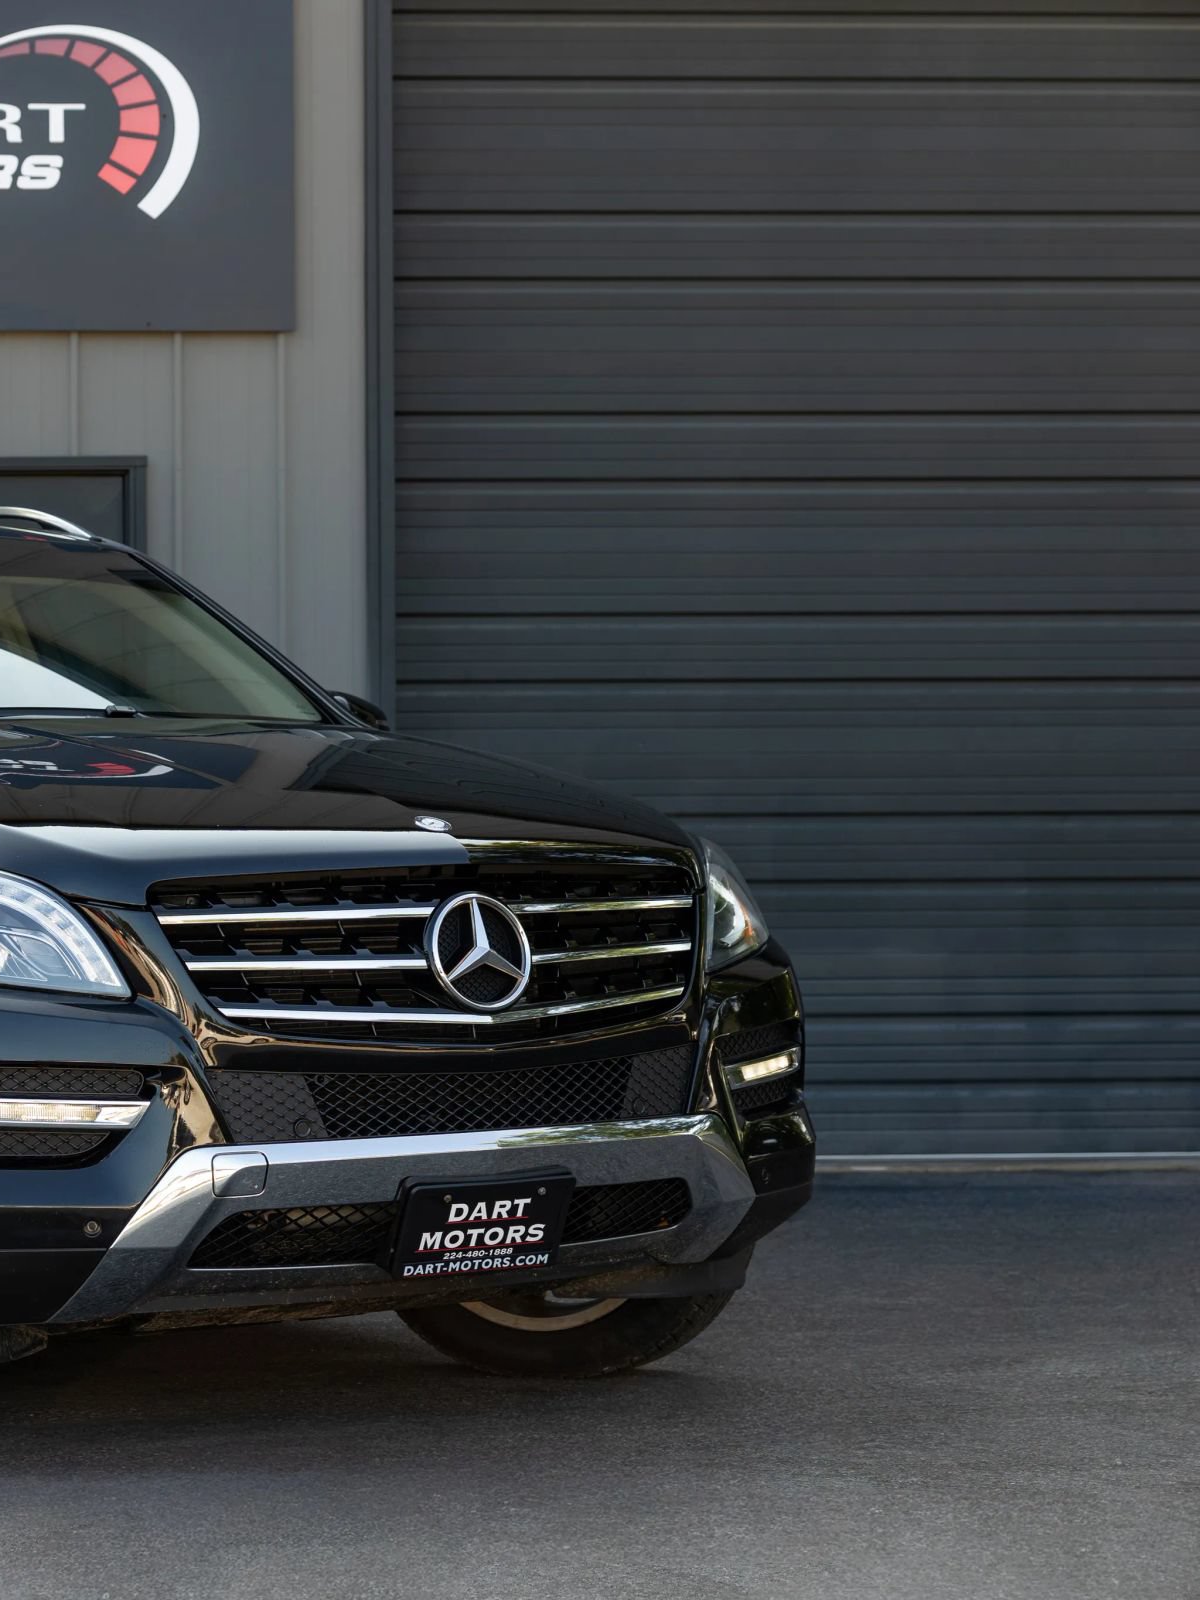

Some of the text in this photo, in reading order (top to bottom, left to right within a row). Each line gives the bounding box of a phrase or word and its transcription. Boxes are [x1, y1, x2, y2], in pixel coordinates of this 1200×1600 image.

[447, 1197, 532, 1223] DART
[418, 1223, 546, 1251] MOTORS
[403, 1253, 549, 1277] DART-MOTORS.COM
[442, 1247, 513, 1260] 224-480-1888
